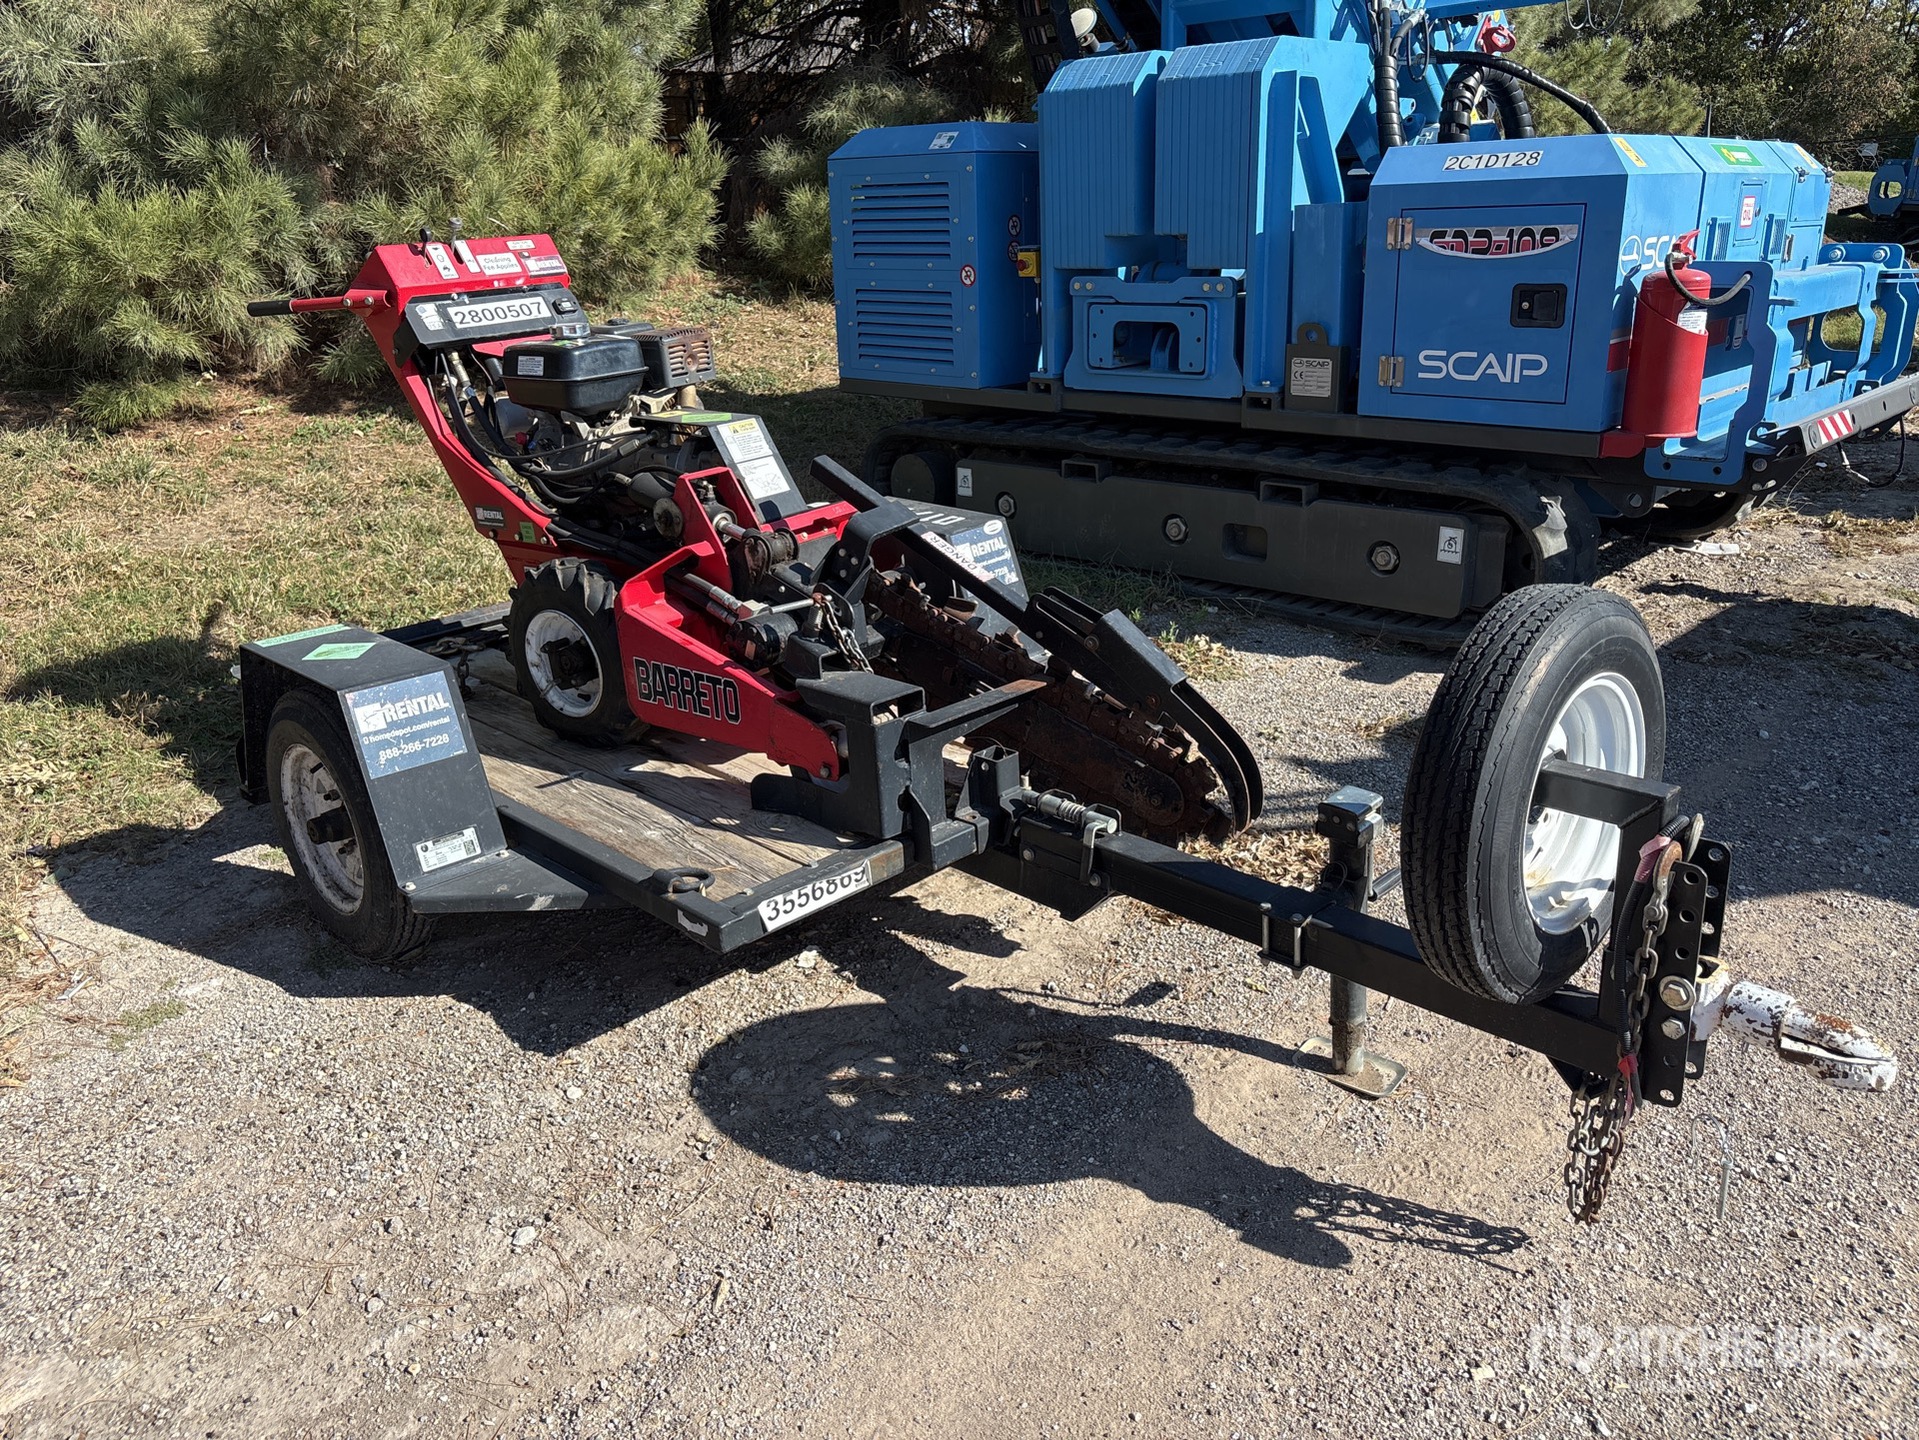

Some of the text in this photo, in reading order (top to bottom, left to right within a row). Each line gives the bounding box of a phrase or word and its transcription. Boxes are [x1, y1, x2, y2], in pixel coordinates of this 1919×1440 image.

[1444, 151, 1541, 171] 2C1D128
[483, 256, 512, 264] Cleaning
[454, 301, 542, 325] 2800507
[1417, 349, 1548, 383] SCAIP
[483, 510, 504, 520] RENTAL
[930, 536, 978, 571] DANGER
[971, 536, 1007, 558] RENTAL
[633, 656, 741, 725] BARRETO
[382, 692, 450, 723] RENTAL
[369, 715, 451, 743] homedepot.com/rental
